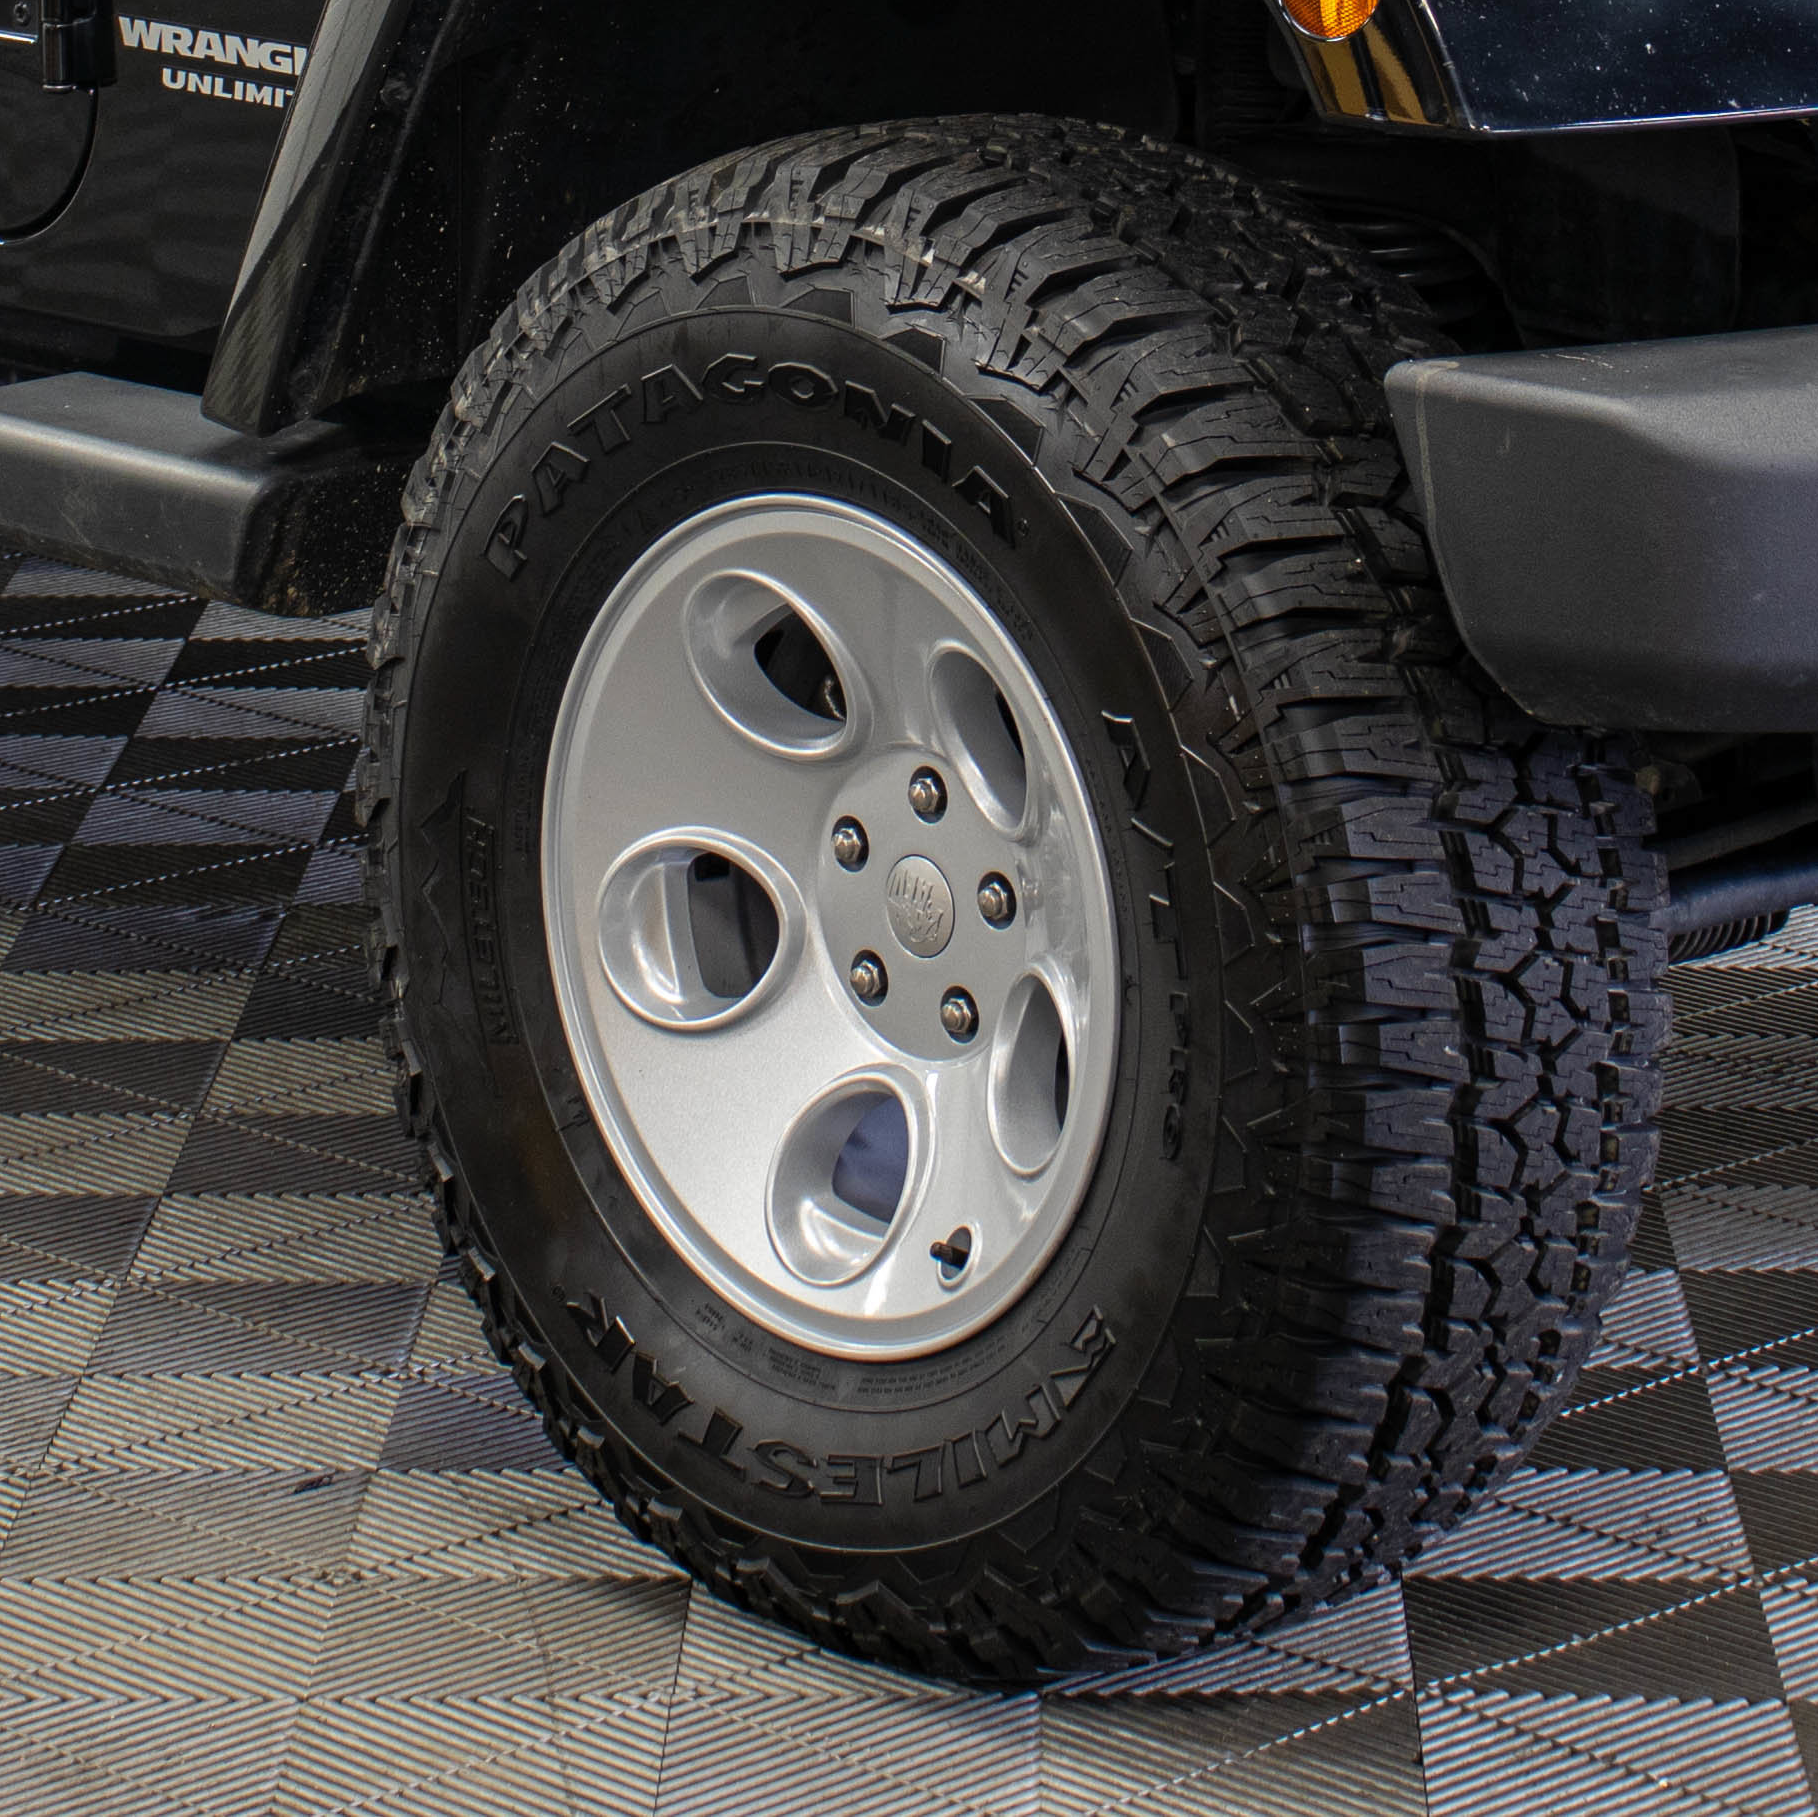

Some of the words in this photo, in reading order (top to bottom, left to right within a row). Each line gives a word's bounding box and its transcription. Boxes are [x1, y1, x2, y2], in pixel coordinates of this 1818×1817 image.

[161, 66, 295, 109] UNLIMI
[483, 351, 1020, 582] PATAGONIA
[565, 1290, 1063, 1506] MILESTAR
